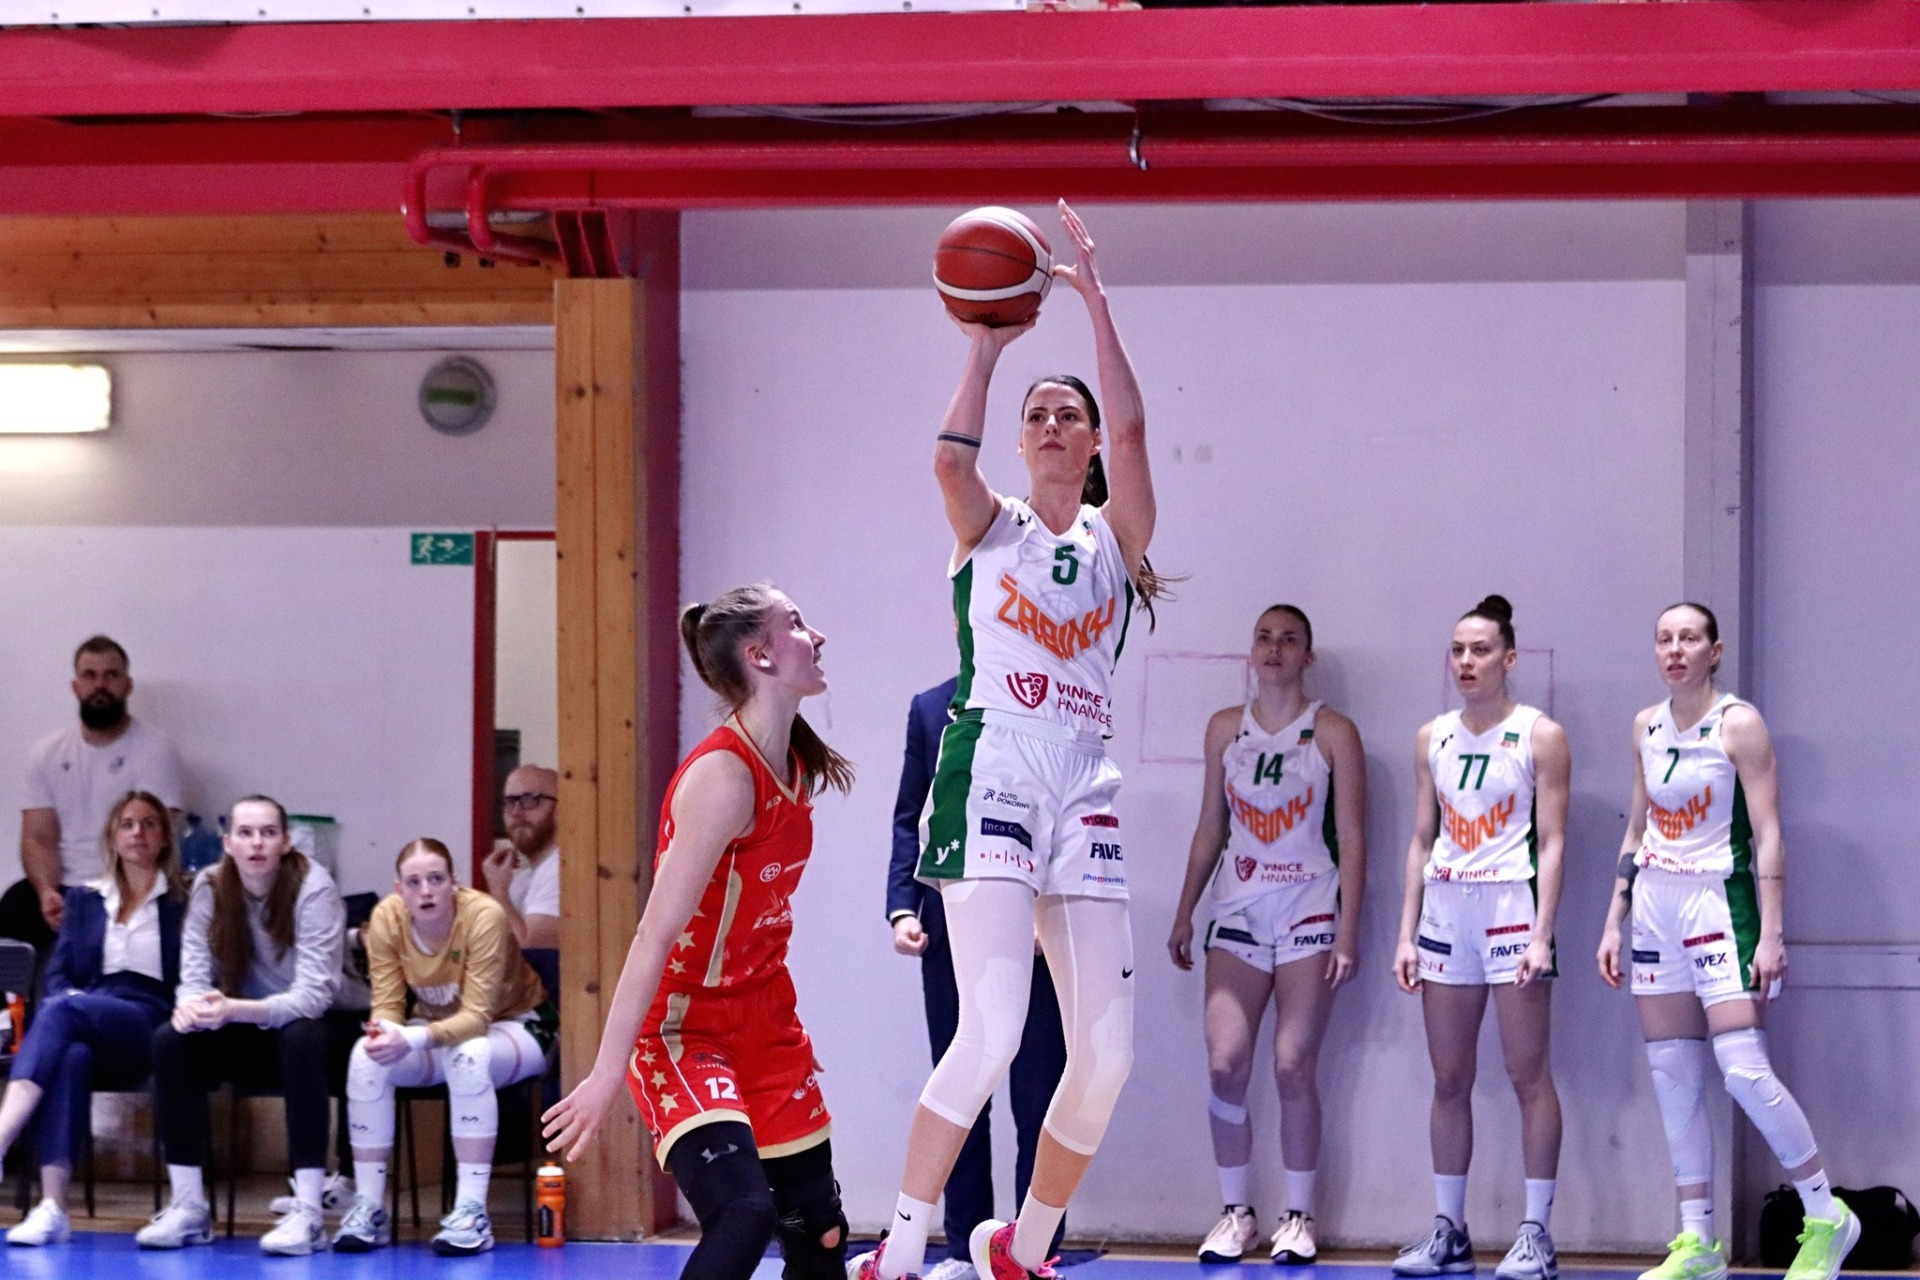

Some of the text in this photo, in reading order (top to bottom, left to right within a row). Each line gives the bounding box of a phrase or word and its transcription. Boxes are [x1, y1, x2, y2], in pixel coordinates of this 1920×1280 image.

[1052, 544, 1080, 585] 5
[997, 572, 1116, 661] ŽABINY
[1056, 681, 1104, 708] VINICE
[1253, 752, 1284, 785] 14
[1457, 754, 1491, 790] 77
[1662, 747, 1680, 784] 7
[998, 791, 1018, 801] AUTO
[984, 821, 1005, 832] Inca
[1089, 842, 1123, 861] FAVE
[1263, 862, 1304, 873] VINICE
[1456, 868, 1500, 881] VINICE
[704, 1076, 739, 1100] 12
